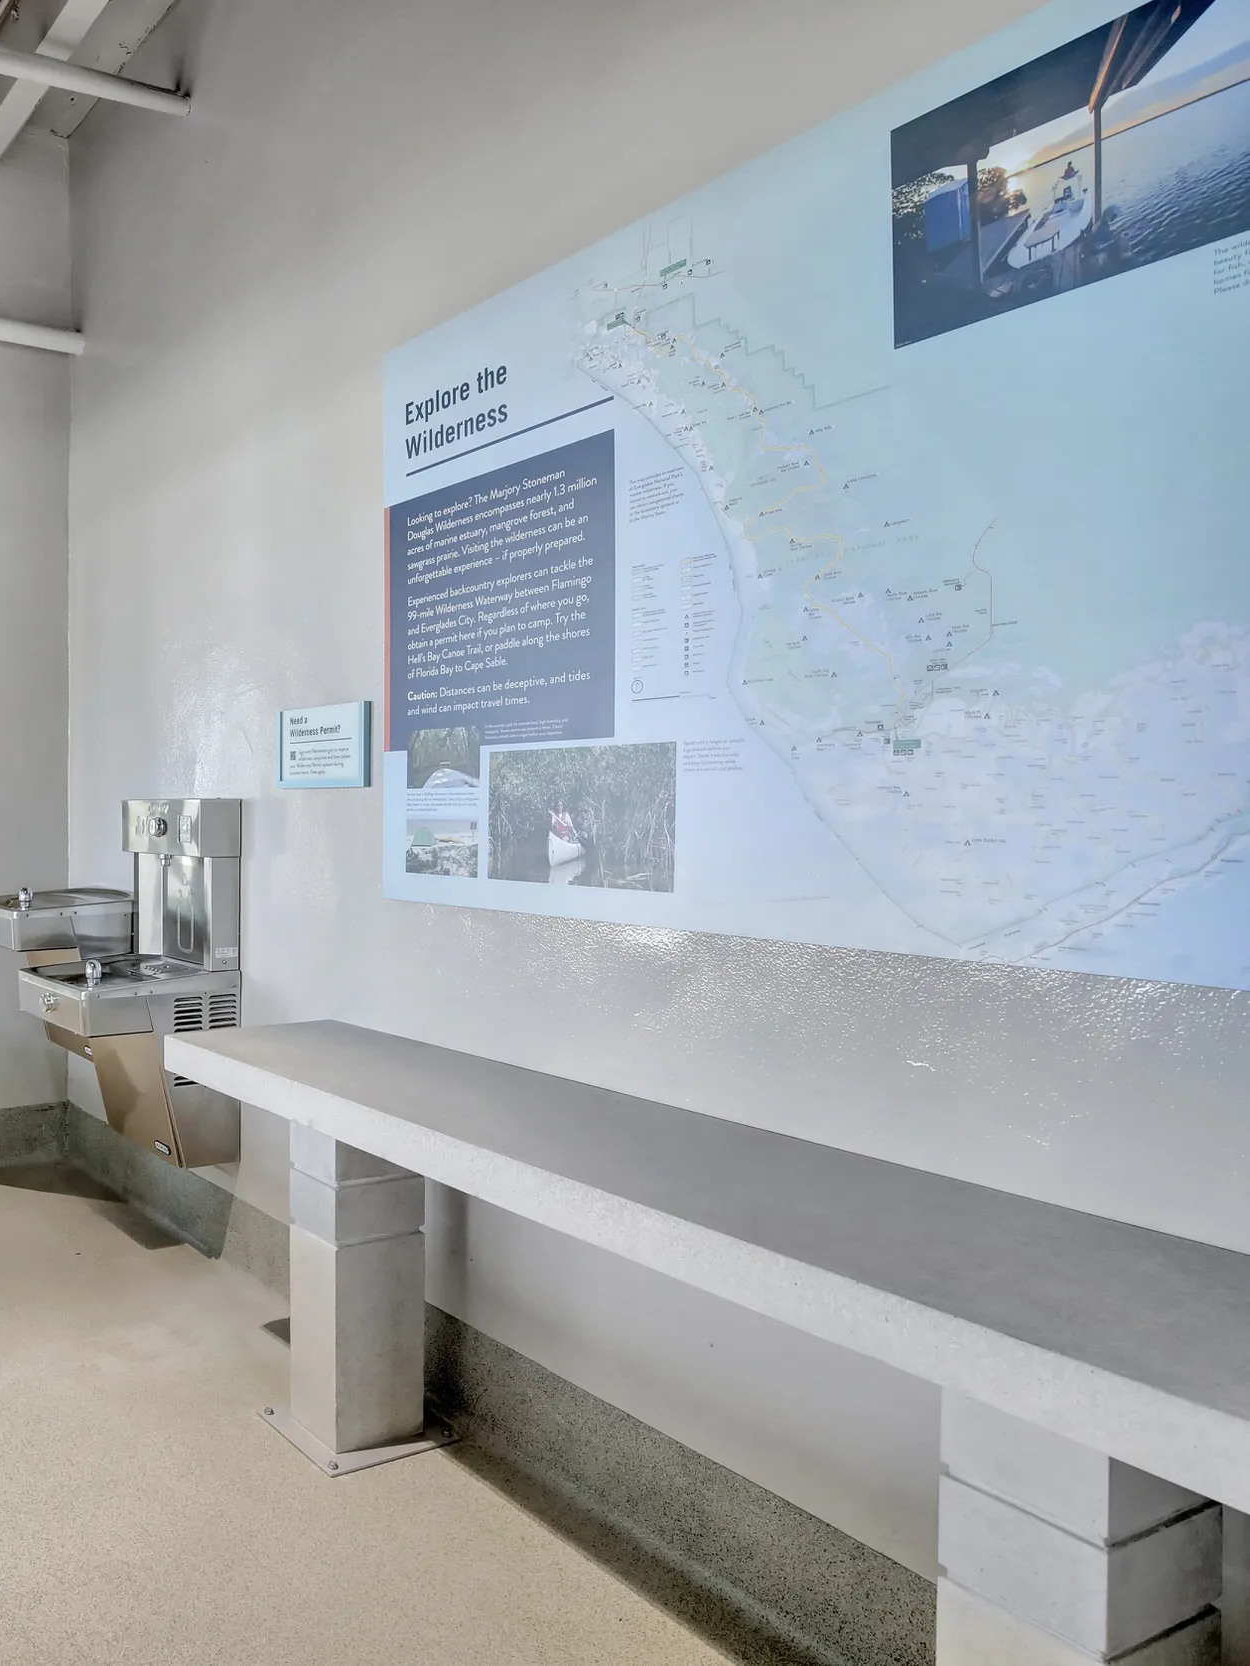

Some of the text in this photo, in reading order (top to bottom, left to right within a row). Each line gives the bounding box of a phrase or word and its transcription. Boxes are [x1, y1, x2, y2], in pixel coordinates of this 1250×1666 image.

[406, 365, 507, 425] Explore the
[405, 404, 508, 459] Wilderness
[408, 469, 565, 527] Looking to explore? The Marjory Stoneman
[408, 477, 597, 542] Douglas Wilderness encompasses nearly 1.3 million
[407, 498, 574, 556] acres of marine estuary, mangrove forest, and
[407, 514, 589, 570] sawgrass prairie. Visiting the wilderness can be an
[407, 566, 452, 585] unforgettable
[453, 556, 493, 574] experience
[502, 550, 509, 560] if
[509, 542, 543, 560] properly
[545, 531, 586, 554] prepared.
[408, 556, 593, 607] Experienced backcountry explorers can tackle the
[408, 575, 592, 621] 99-mile Wilderness Waterway between Flamingo
[408, 594, 590, 635] and Everglades City. Regardless of where you go,
[408, 638, 428, 650] obtain
[434, 631, 457, 648] permit
[459, 630, 475, 640] here
[477, 627, 483, 638] if
[484, 627, 498, 641] you
[500, 622, 516, 638] plan
[518, 622, 526, 631] to
[528, 618, 553, 631] camp.
[555, 612, 569, 625] Try
[570, 610, 586, 622] the
[408, 655, 508, 679] of Florida Bay to Cape Sable.
[427, 650, 441, 663] Bay
[442, 647, 465, 659] Canoe
[466, 643, 484, 655] Trail,
[485, 643, 494, 652] or
[495, 637, 521, 655] paddle
[521, 634, 544, 648] along
[546, 630, 559, 642] the
[562, 627, 590, 640] shores
[407, 695, 530, 716] and wind can impact travel times.
[408, 670, 591, 701] Caution: Distances can be deceptive, and tides
[290, 716, 303, 725] Need
[290, 725, 341, 737] Wilderness Permit?
